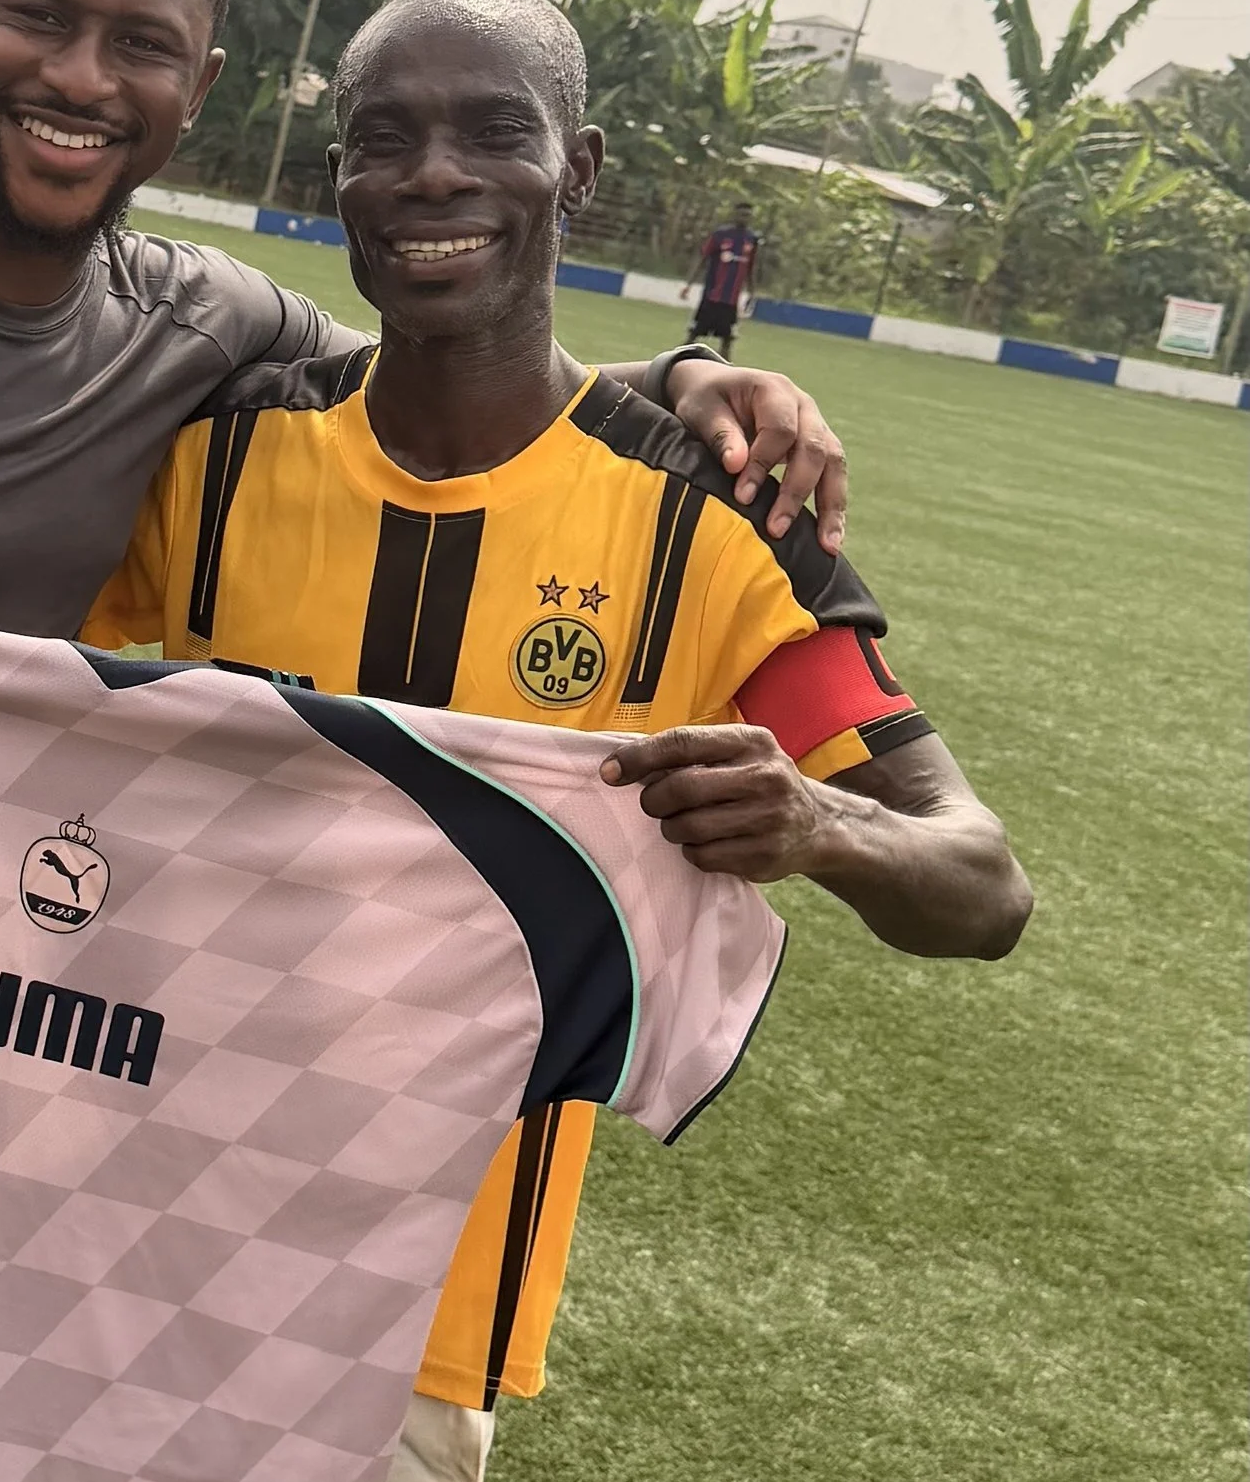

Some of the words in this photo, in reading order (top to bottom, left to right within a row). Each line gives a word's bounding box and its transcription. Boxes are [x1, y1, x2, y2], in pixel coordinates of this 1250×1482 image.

[527, 625, 597, 682] BVB
[543, 674, 569, 695] 09
[37, 902, 76, 919] 1948
